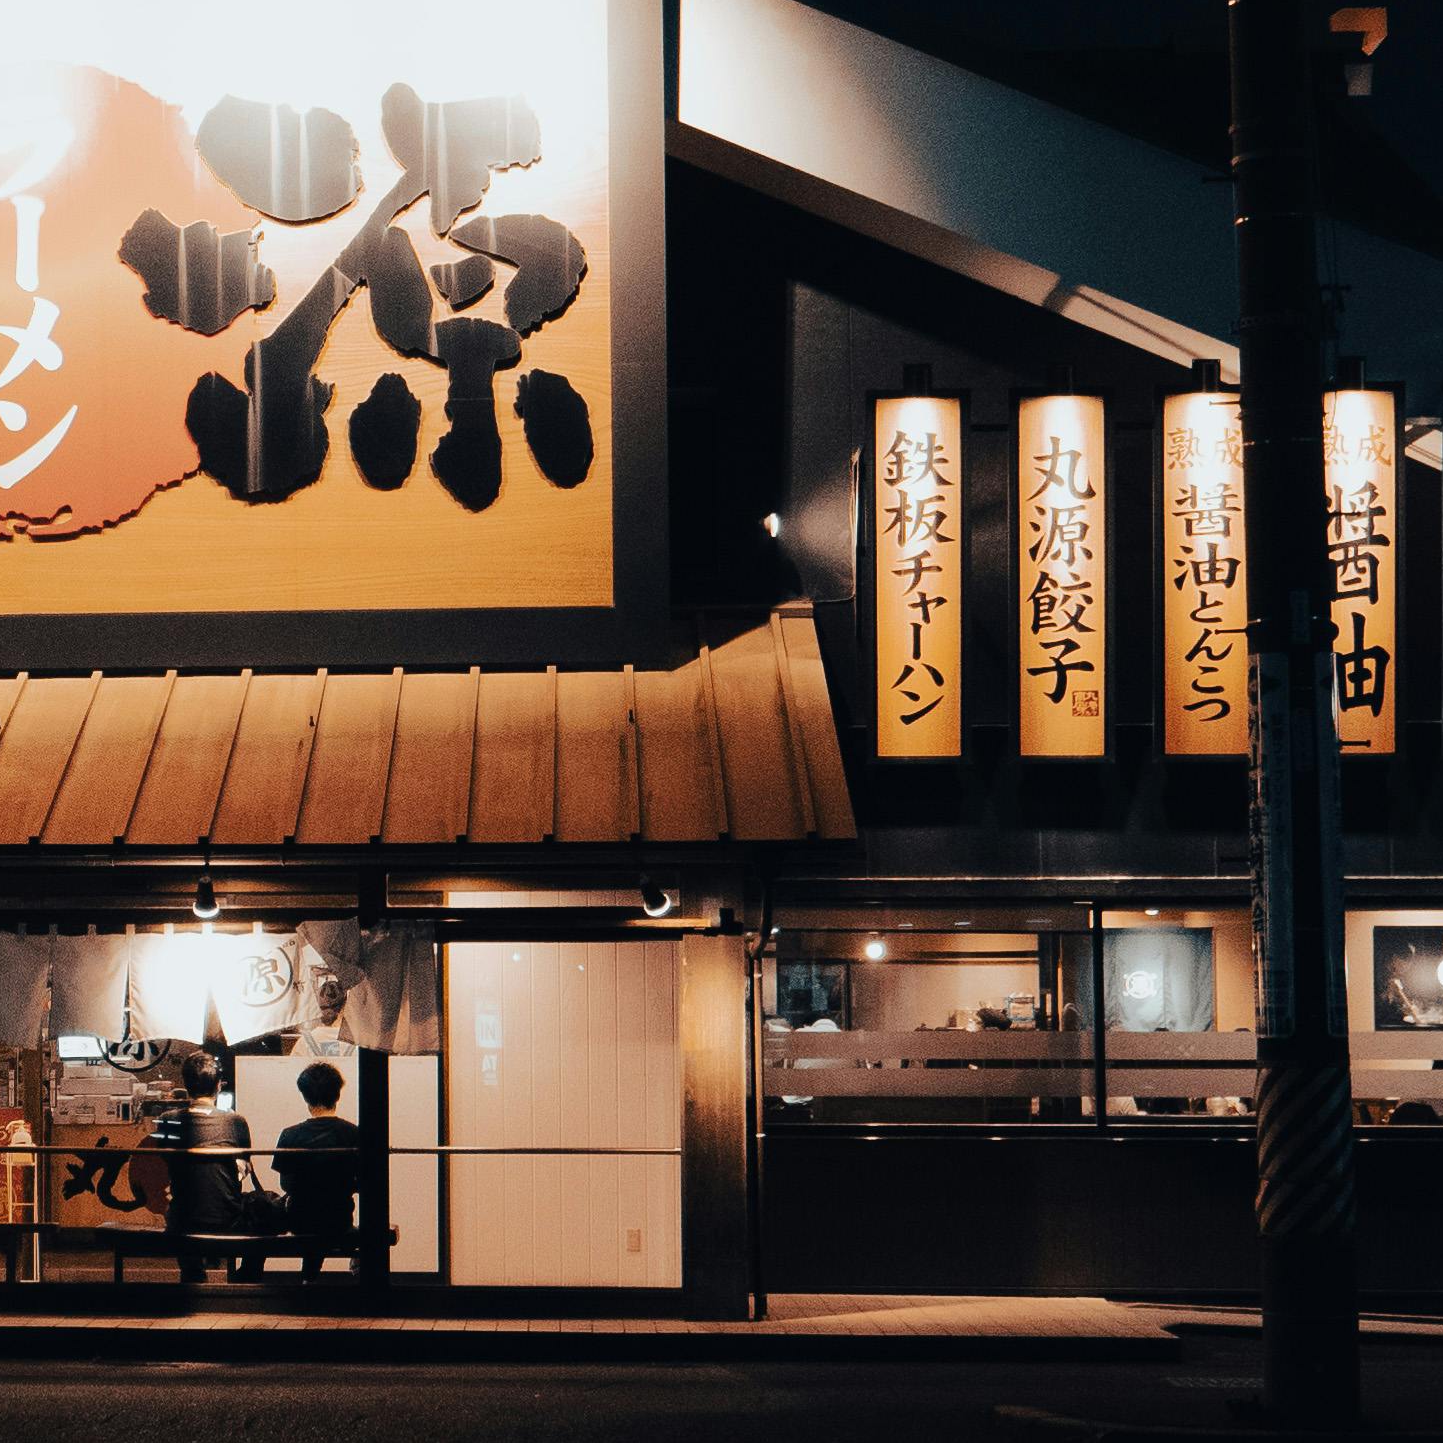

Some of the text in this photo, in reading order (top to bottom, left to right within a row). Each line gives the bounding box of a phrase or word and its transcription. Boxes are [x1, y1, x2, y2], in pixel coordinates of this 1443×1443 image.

[882, 429, 956, 724] 鉄板チャーハン
[1027, 436, 1095, 705] 丸源餃子
[1173, 483, 1241, 722] 醤油とんこつ
